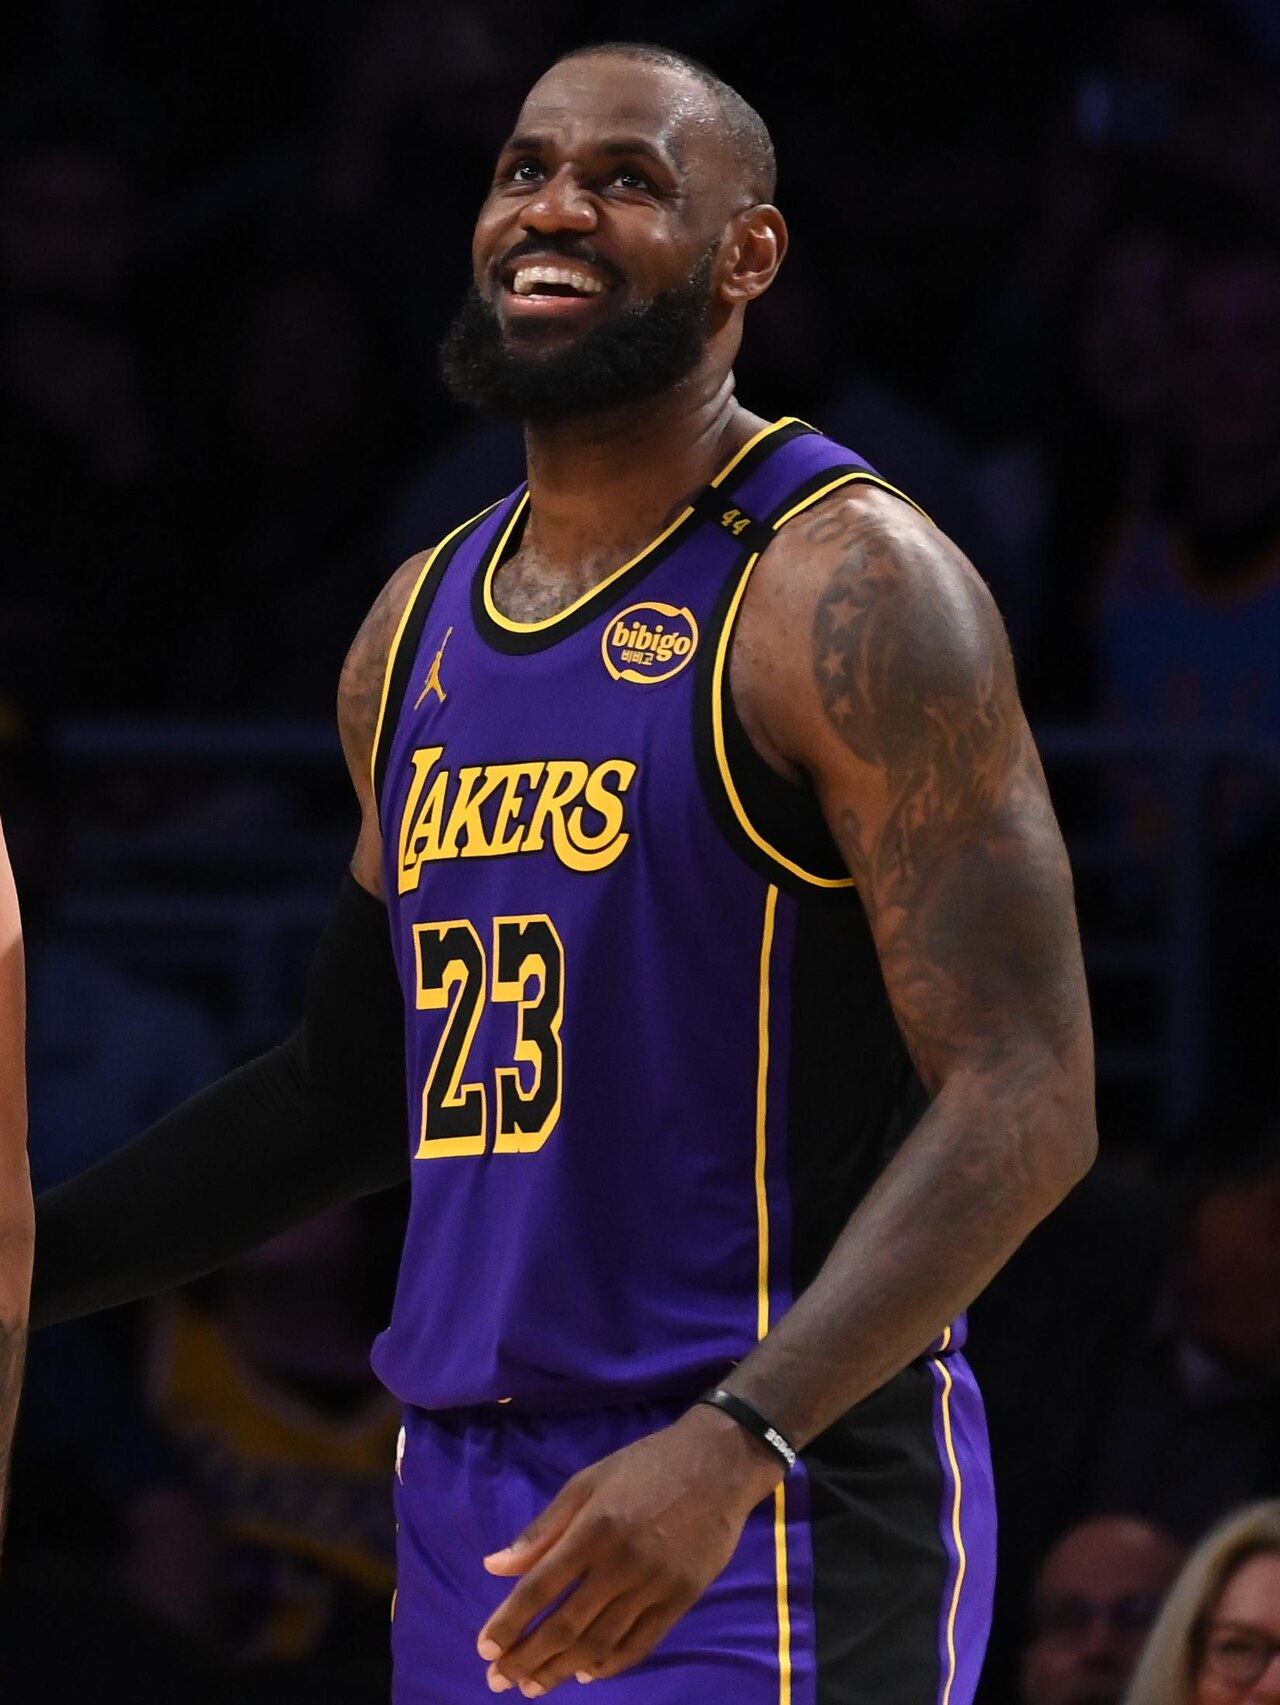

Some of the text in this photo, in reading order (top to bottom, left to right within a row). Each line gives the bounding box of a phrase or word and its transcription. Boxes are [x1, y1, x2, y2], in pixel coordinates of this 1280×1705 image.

[721, 508, 751, 536] 44
[612, 621, 692, 662] bibigo
[620, 649, 655, 666] 비비고
[397, 746, 637, 896] LAKERS
[412, 913, 565, 1160] 23
